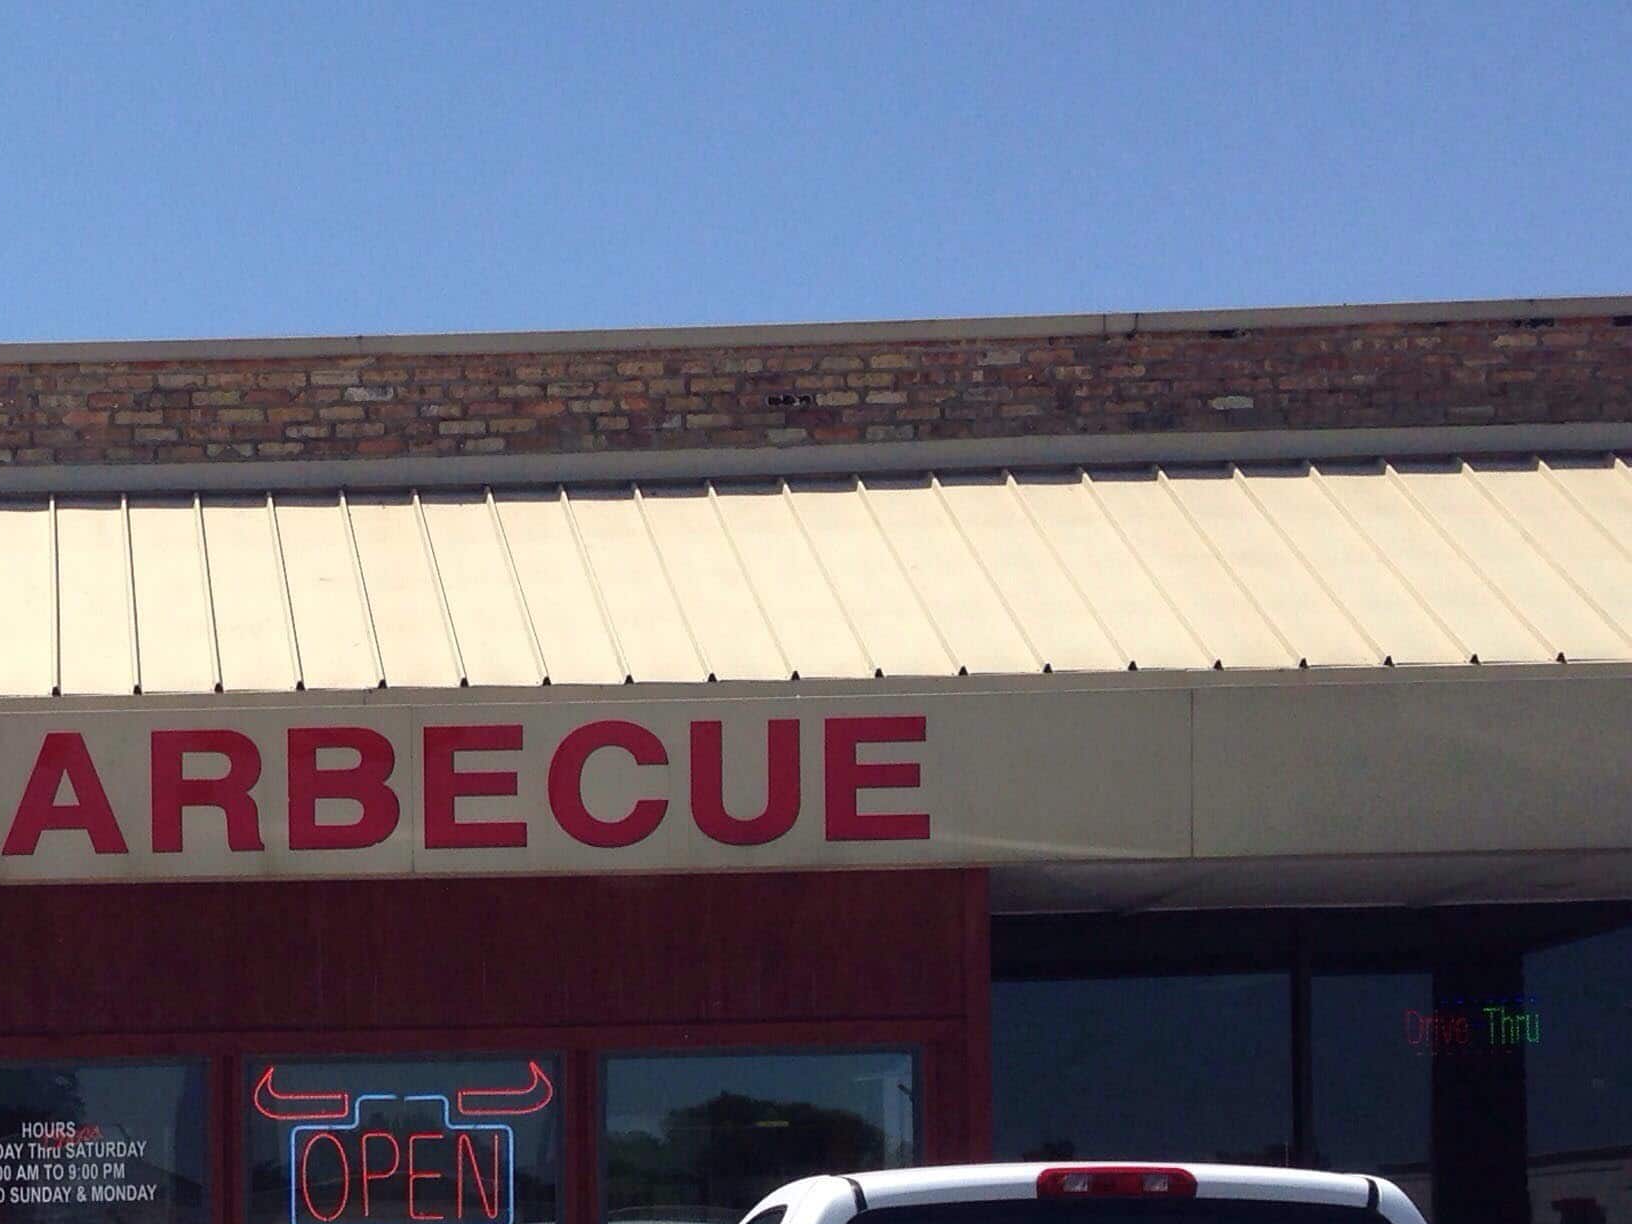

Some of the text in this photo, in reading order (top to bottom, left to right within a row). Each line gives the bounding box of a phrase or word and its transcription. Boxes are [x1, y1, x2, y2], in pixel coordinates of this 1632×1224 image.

[1406, 1007, 1541, 1045] Drive Thru
[21, 1121, 76, 1138] HOURS
[28, 1143, 61, 1159] Thru
[66, 1141, 147, 1157] SATURDAY
[16, 1165, 39, 1181] AM
[43, 1164, 64, 1180] TO
[68, 1163, 98, 1179] 9:00
[103, 1163, 125, 1178] PM
[302, 1132, 500, 1221] OPEN
[10, 1187, 72, 1203] SUNDAY
[76, 1186, 87, 1201] &
[92, 1184, 157, 1200] MONDAY
